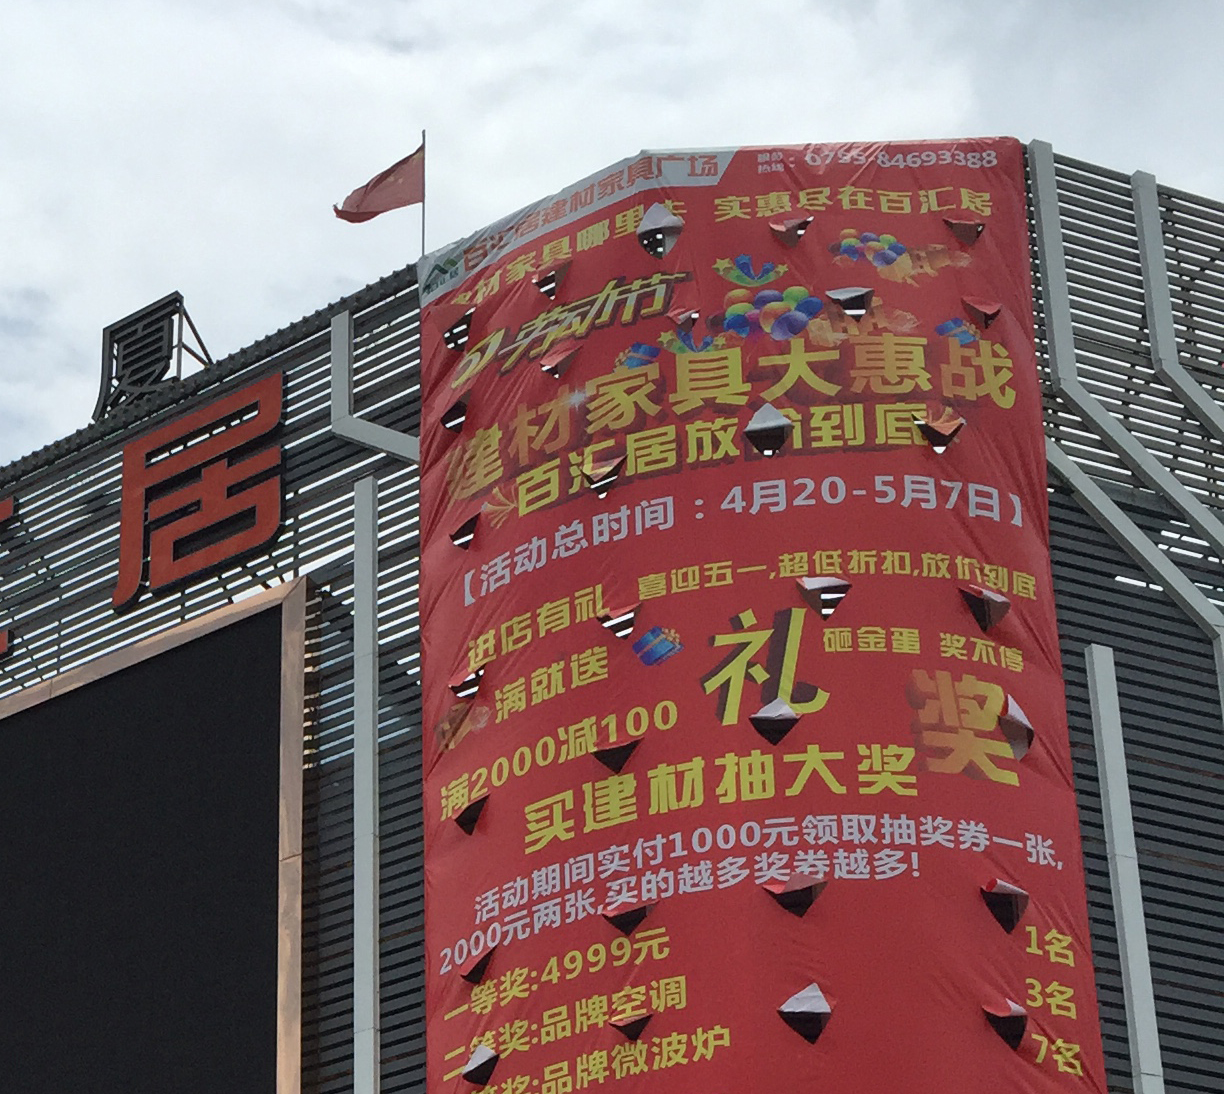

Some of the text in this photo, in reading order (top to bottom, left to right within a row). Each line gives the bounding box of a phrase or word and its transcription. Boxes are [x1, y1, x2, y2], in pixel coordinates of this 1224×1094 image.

[714, 186, 992, 223] 实惠尽在百汇居
[447, 332, 1017, 501] 建材家具大惠战
[467, 583, 611, 673] 进店有礼
[705, 607, 830, 727] 礼
[822, 625, 1025, 672] 砸金蛋 奖不停
[495, 646, 609, 724] 满就送
[910, 668, 1021, 788] 奖
[439, 700, 678, 822] 满2000减100
[524, 743, 919, 855] 买建材抽大奖
[443, 926, 1077, 1022] 一等奖:4999元 1名
[1024, 978, 1079, 1020] 3名
[1031, 1034, 1084, 1078] 7名
